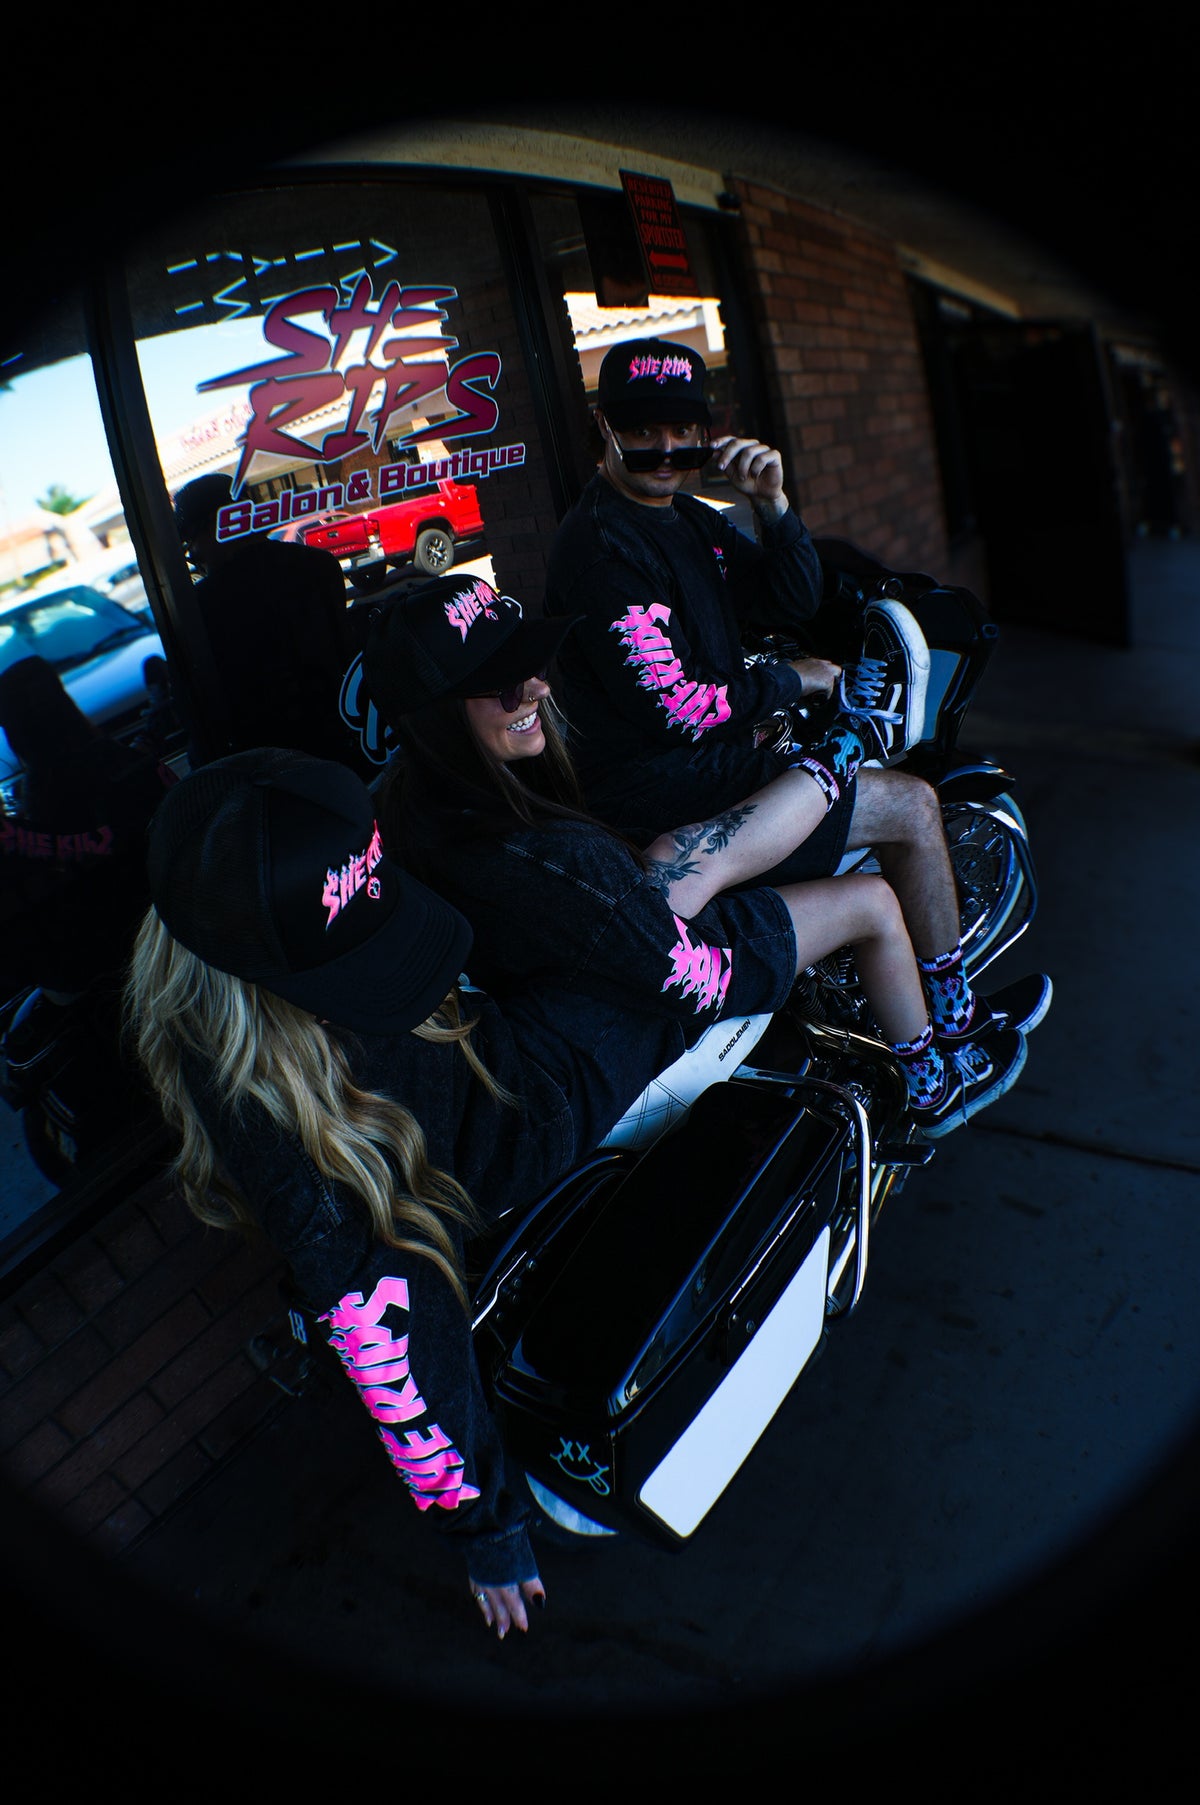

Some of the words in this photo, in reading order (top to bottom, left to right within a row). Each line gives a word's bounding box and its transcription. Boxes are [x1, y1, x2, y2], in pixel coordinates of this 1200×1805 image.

[632, 191, 673, 211] PARKING
[196, 271, 460, 394] SHE
[626, 353, 662, 385] SHE
[661, 353, 693, 384] RIPS
[230, 351, 502, 500] RIPS
[216, 483, 345, 543] Salon
[346, 469, 375, 503] &
[379, 442, 526, 498] Boutique
[442, 587, 484, 645] SHE
[607, 602, 686, 691] RIPS
[654, 680, 733, 743] SHE
[321, 848, 368, 933] SHE
[718, 1018, 752, 1062] SADDLEMEN
[314, 1275, 428, 1424] RIPS
